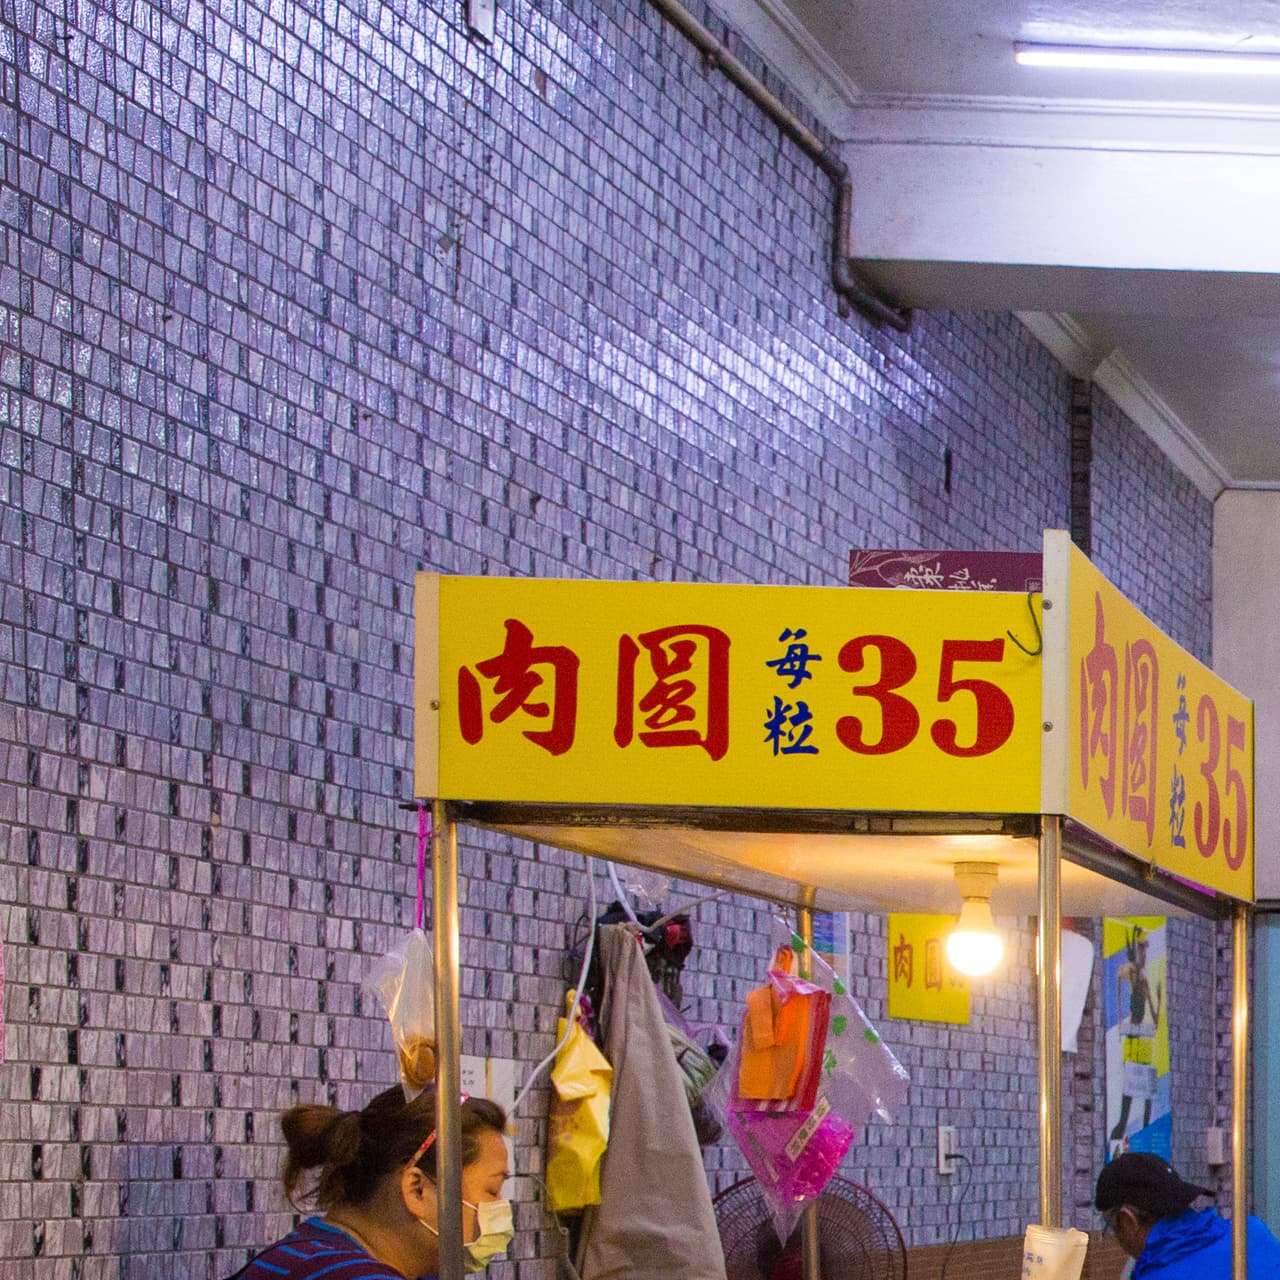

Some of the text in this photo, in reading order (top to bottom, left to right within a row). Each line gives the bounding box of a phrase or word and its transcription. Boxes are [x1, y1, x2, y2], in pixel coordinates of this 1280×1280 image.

[458, 618, 1015, 761] 肉圓 每粒 35
[1080, 590, 1248, 872] 肉圓 每粒 35
